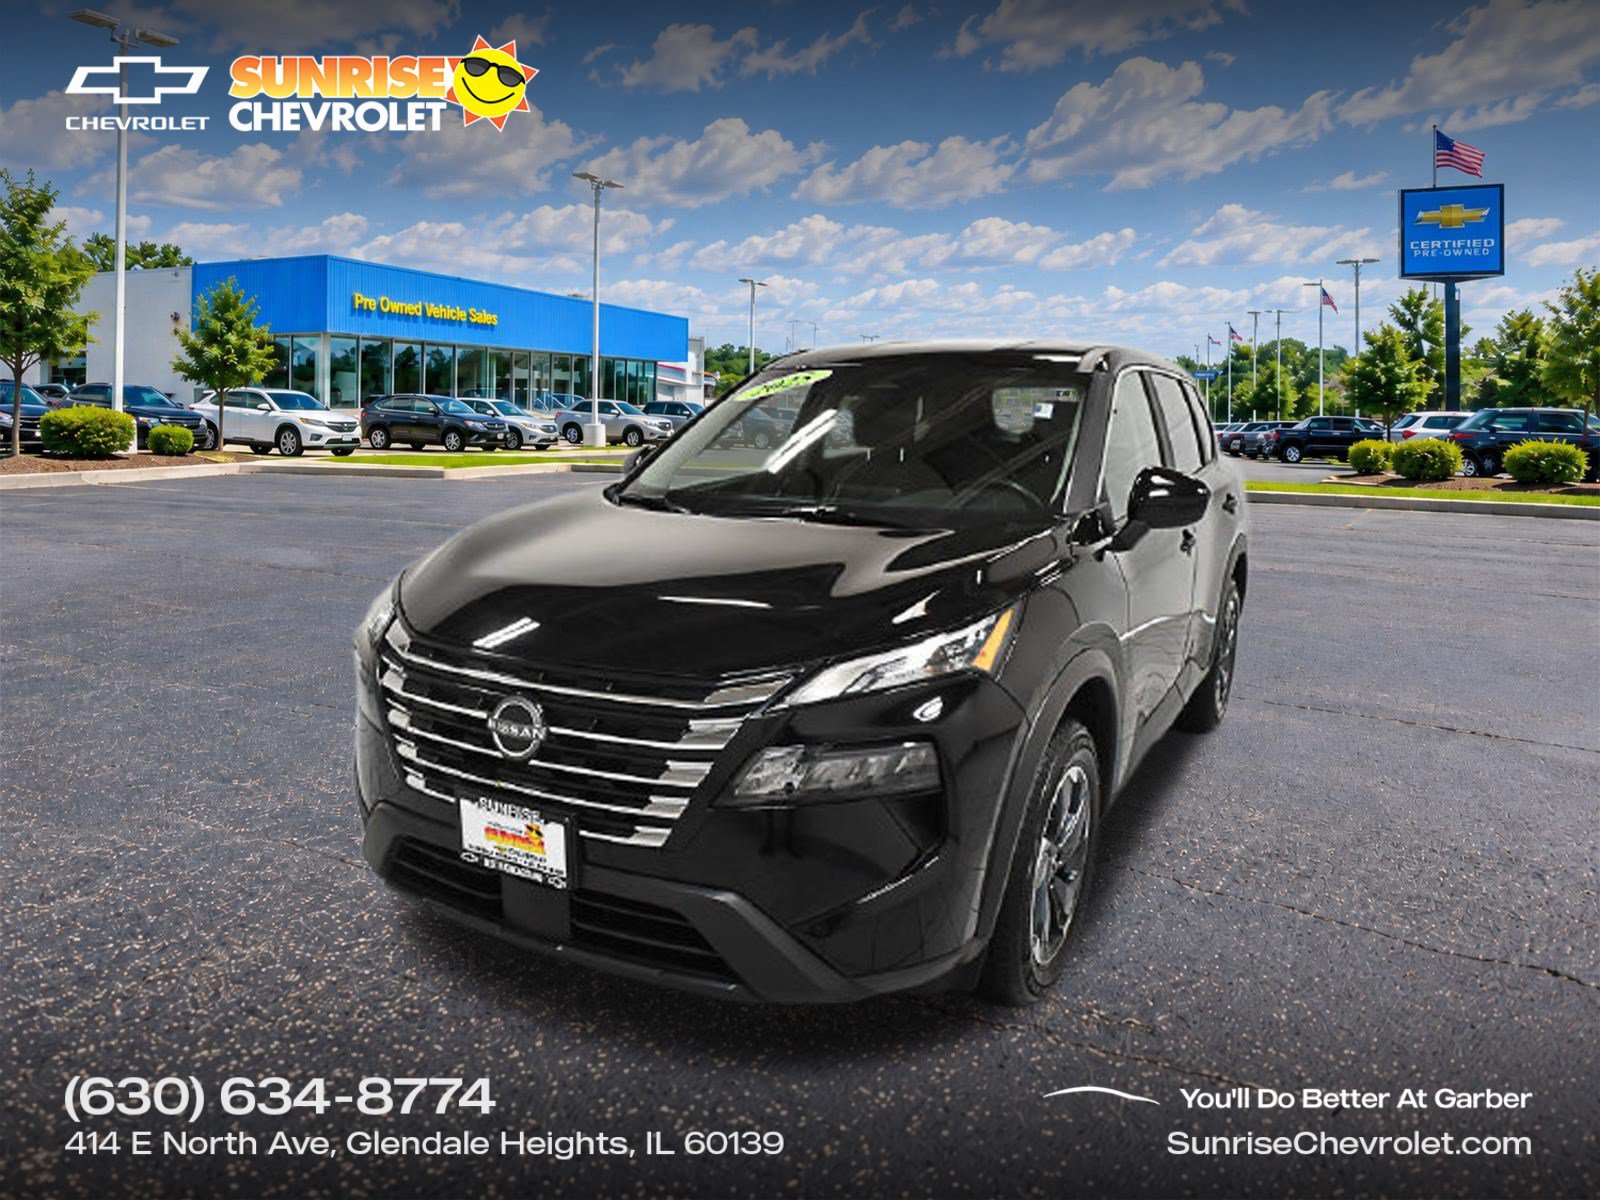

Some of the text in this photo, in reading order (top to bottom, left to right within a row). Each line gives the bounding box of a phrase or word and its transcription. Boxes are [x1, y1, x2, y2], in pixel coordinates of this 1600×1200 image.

[1410, 238, 1495, 250] CERTIFIED
[1414, 248, 1490, 257] PRE-OWNED
[354, 293, 498, 325] Pre Owned Vehicle Sales
